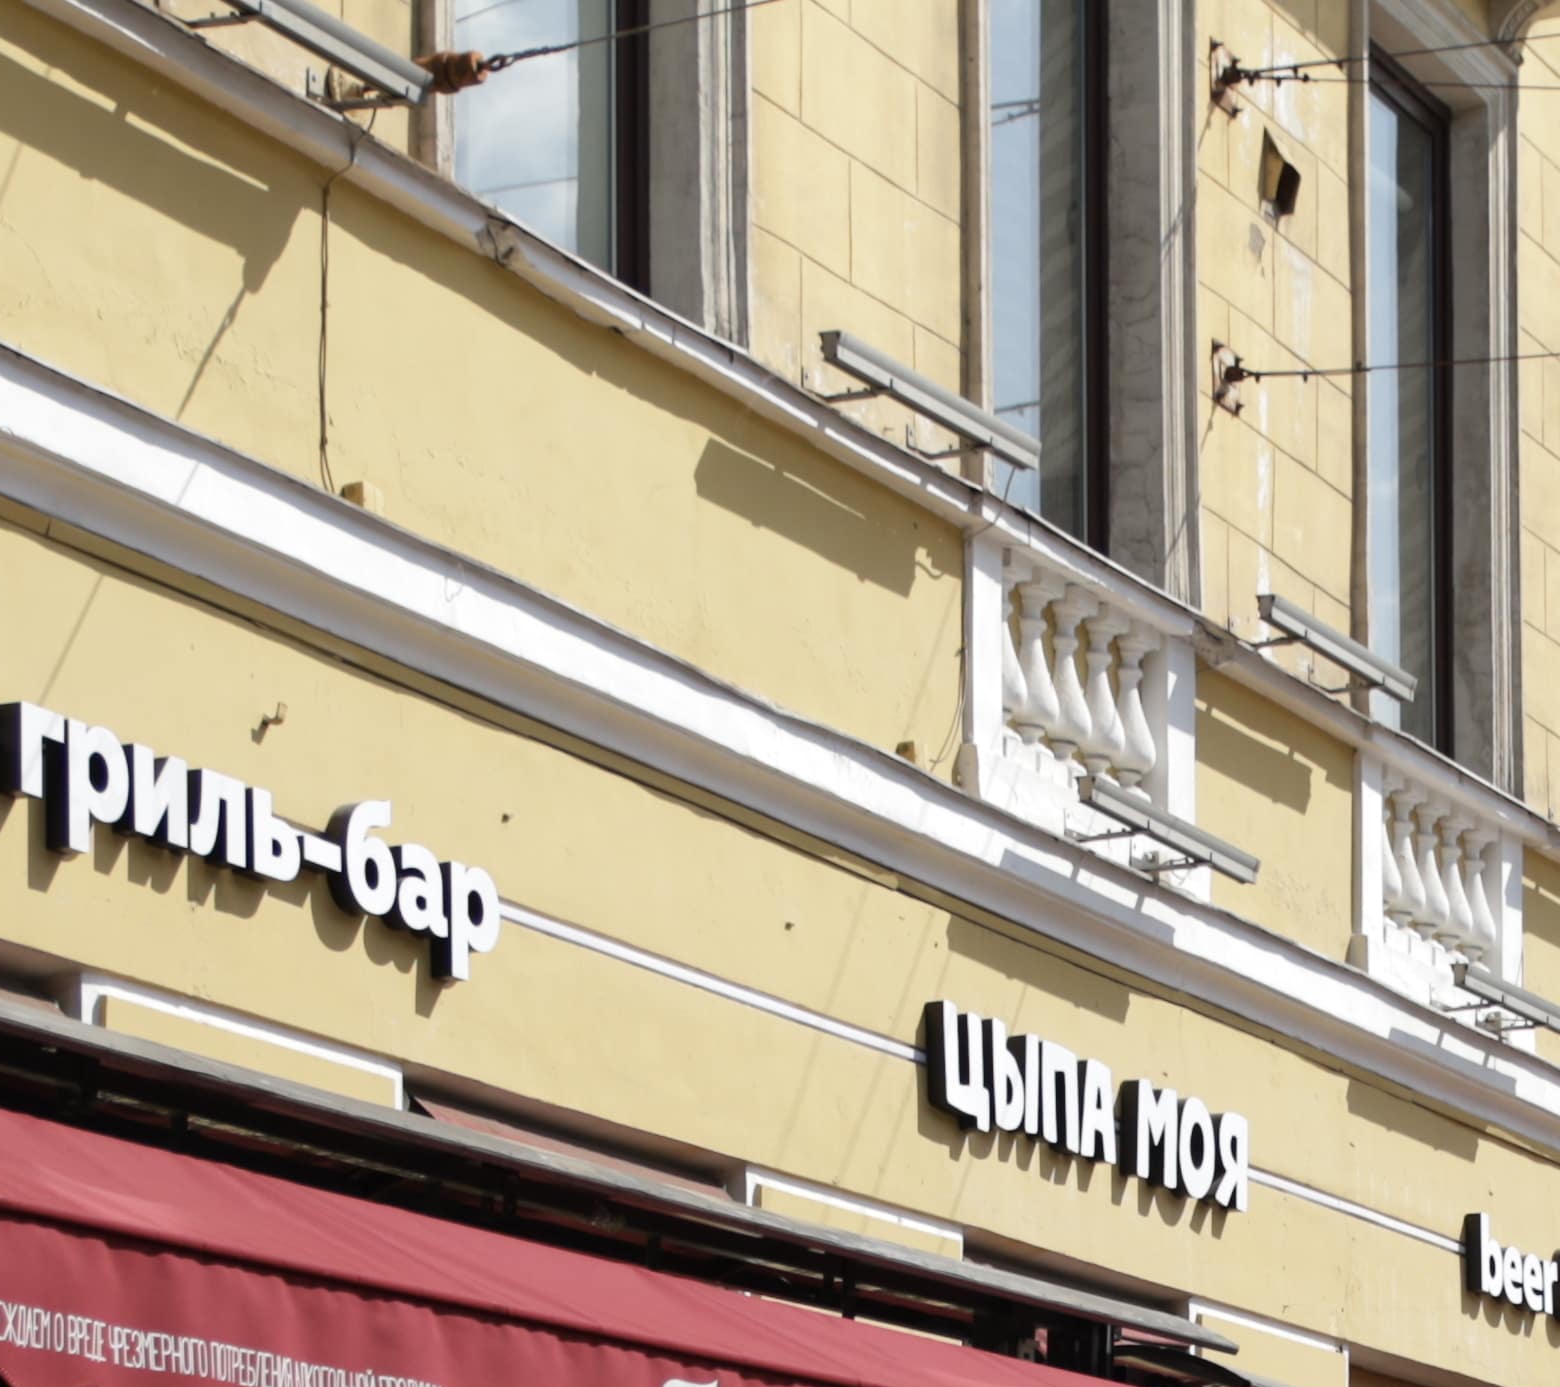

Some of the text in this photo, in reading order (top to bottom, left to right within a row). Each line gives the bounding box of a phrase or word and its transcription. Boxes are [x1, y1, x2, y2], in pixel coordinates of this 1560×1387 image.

[926, 1000, 1249, 1212] ЦЫПА МОЯ
[1465, 1212, 1557, 1319] beer
[52, 1311, 65, 1353] О
[66, 1314, 107, 1363] ВРЕДЕ
[107, 1323, 209, 1378] ЧРЕЗМЕРНОГО
